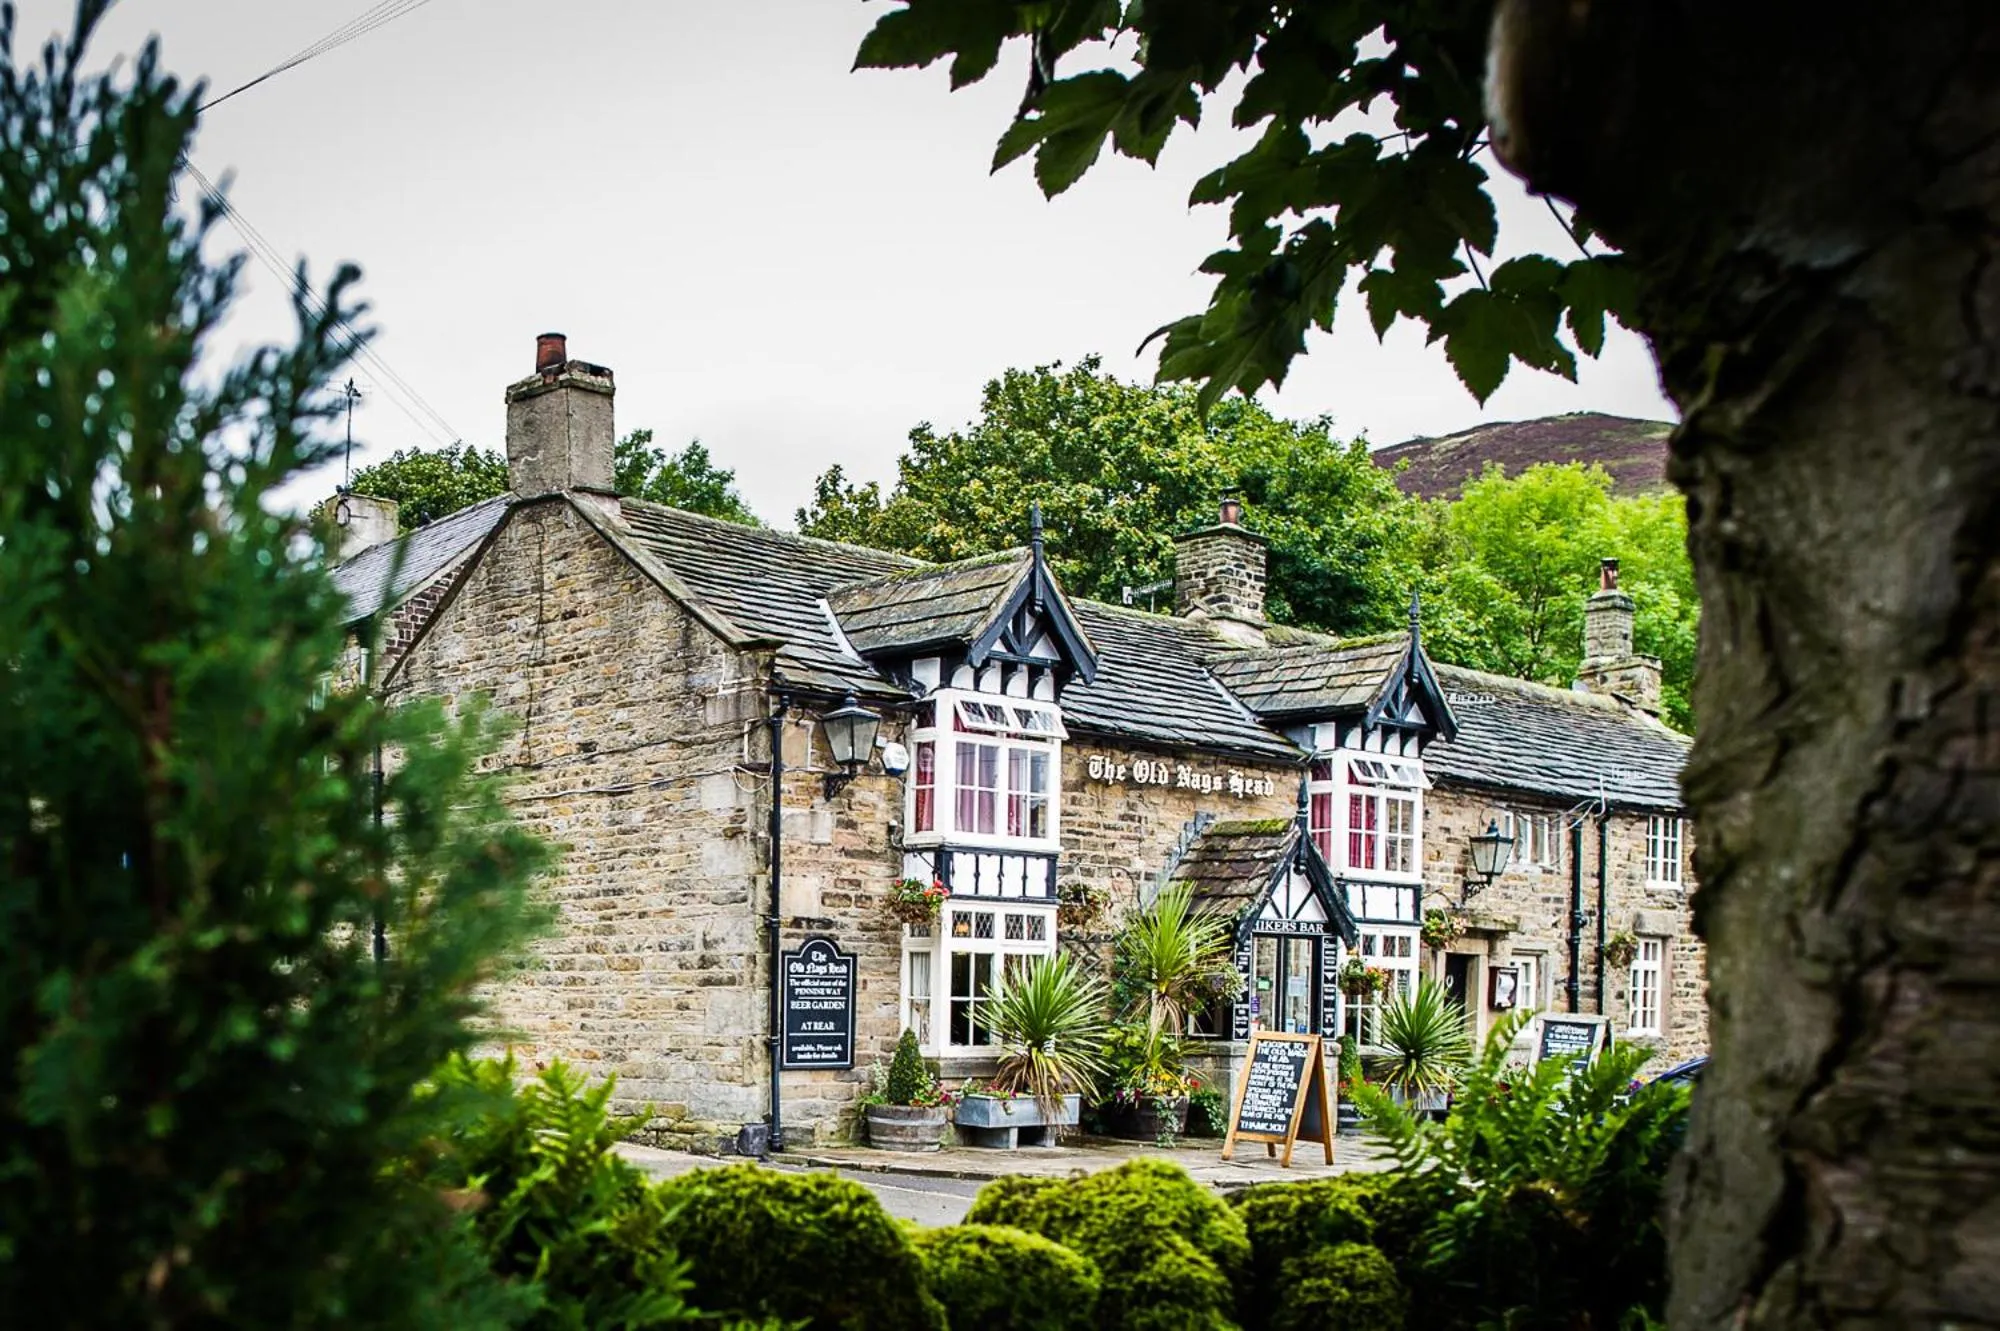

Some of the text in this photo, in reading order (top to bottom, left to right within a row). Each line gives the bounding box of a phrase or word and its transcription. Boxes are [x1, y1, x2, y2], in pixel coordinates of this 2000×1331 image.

[1087, 754, 1275, 799] The Old Nags Head
[1300, 922, 1325, 933] BAR
[811, 950, 827, 963] The
[789, 961, 848, 975] Old Nags Head
[789, 978, 800, 986] The
[801, 978, 820, 986] official
[838, 979, 848, 987] the
[795, 987, 842, 996] PENNINE WAY
[790, 1000, 846, 1010] BEER GARDEN
[801, 1021, 835, 1031] AT REAR
[1257, 1046, 1270, 1055] THE
[1270, 1047, 1287, 1056] OLD
[1268, 1122, 1287, 1132] YOU
